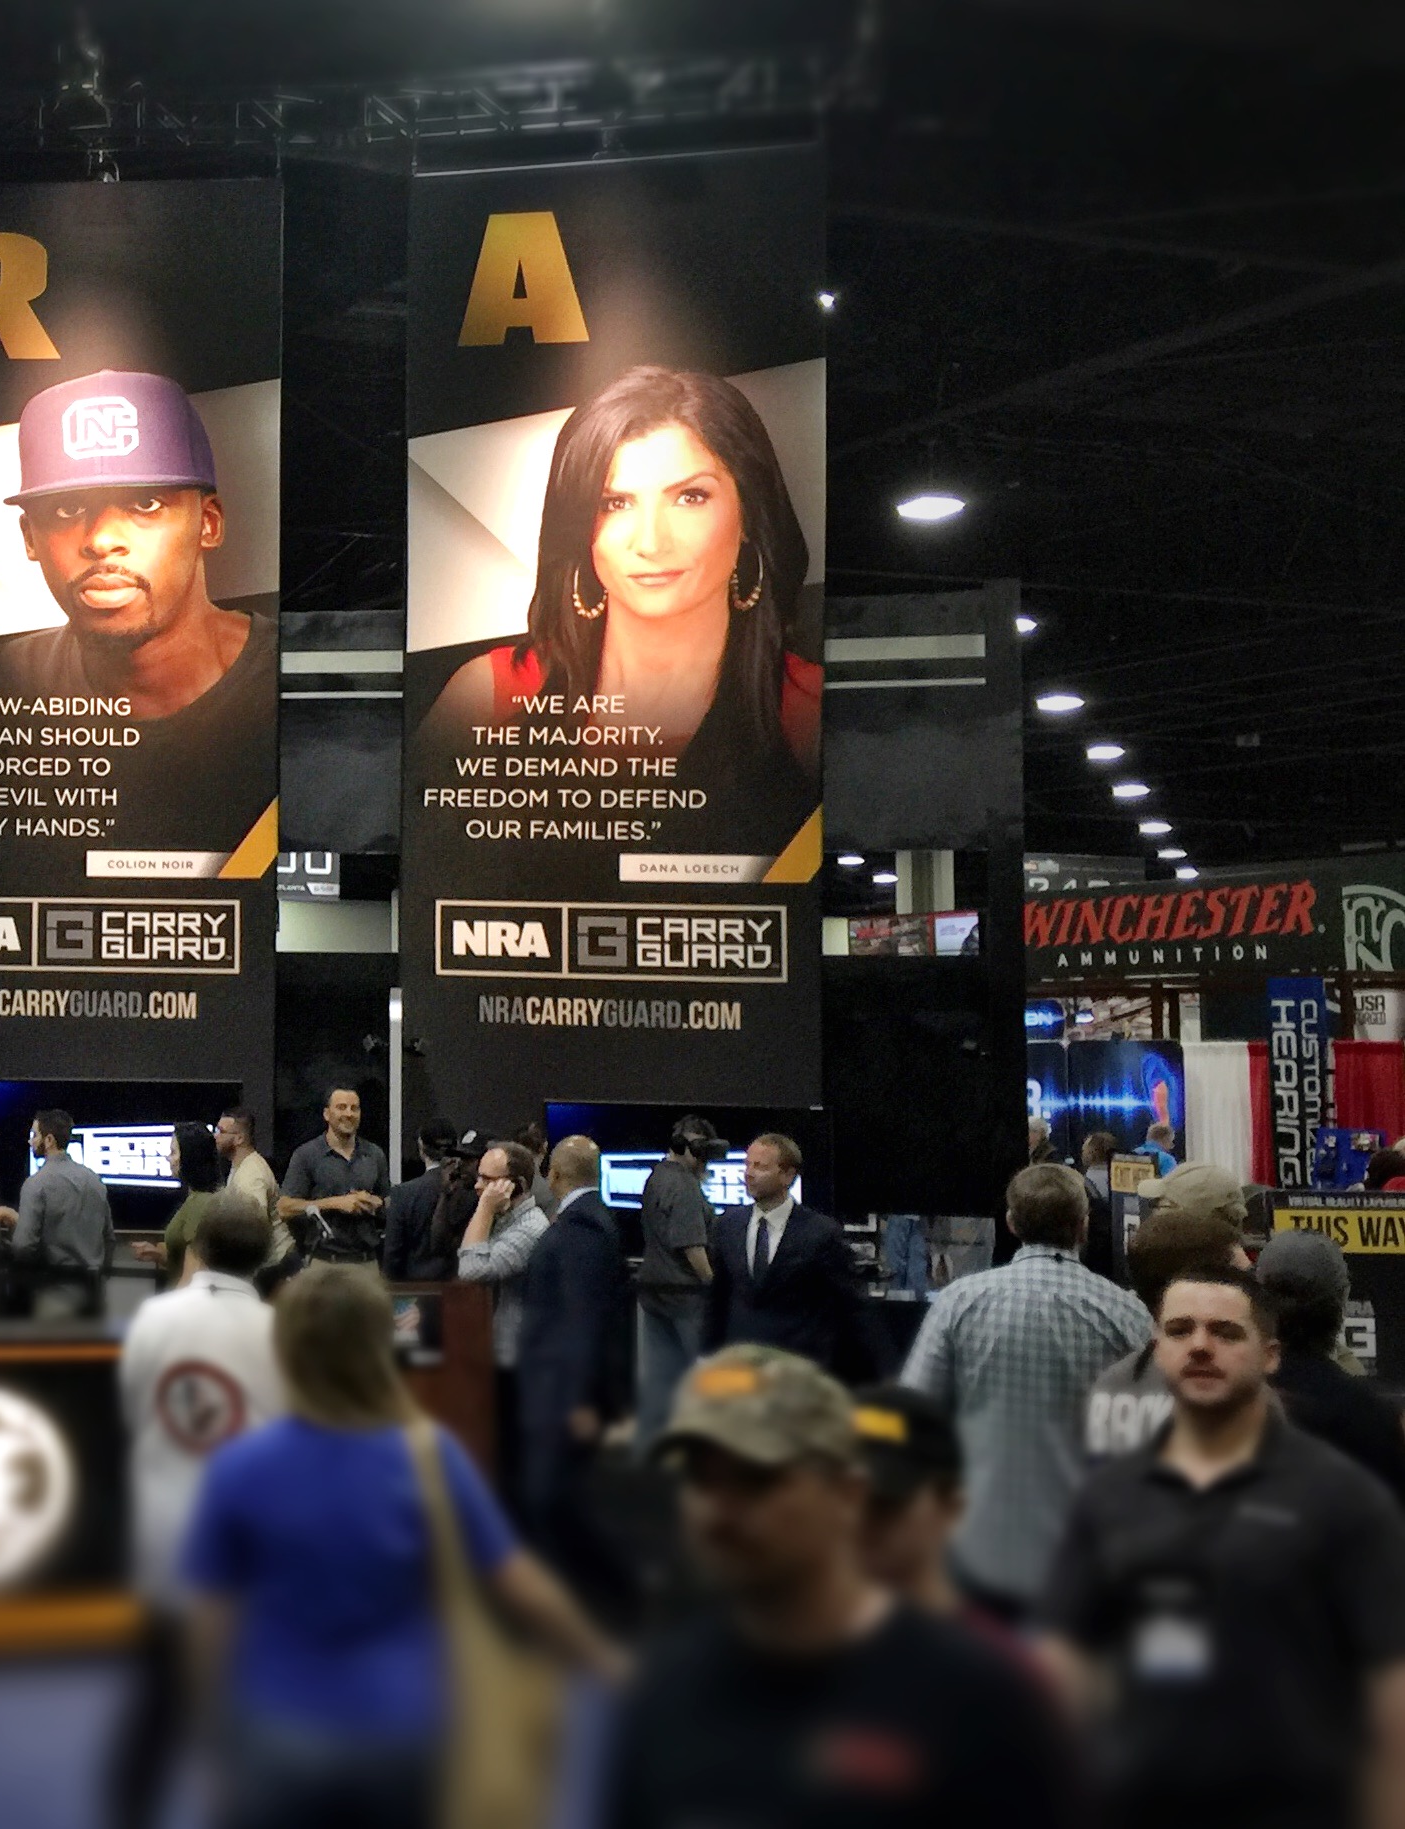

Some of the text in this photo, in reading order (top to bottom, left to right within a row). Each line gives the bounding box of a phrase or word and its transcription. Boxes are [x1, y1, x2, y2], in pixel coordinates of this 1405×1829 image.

[458, 211, 590, 347] A
[572, 694, 626, 715] ARE
[40, 727, 141, 748] SHOULD
[472, 725, 664, 746] THE MAJORITY.
[78, 757, 112, 778] TO
[455, 757, 678, 778] WE DEMAND THE
[54, 787, 118, 808] WITH
[423, 788, 707, 810] FREEDOM TO DEFEND
[465, 820, 522, 840] OUR
[107, 859, 194, 870] COLION NOIR
[639, 863, 741, 875] DANA LOESCH
[101, 911, 227, 936] CARRY
[1024, 879, 1317, 949] WINCHESTER
[451, 919, 551, 959] NRA
[636, 917, 773, 943] CARRY
[101, 936, 226, 961] GUARD
[636, 943, 773, 969] GUARD
[1057, 944, 1269, 968] AMMUNITION
[478, 995, 742, 1031] NRACARRYGUARD.COM
[1270, 999, 1302, 1190] HEARING
